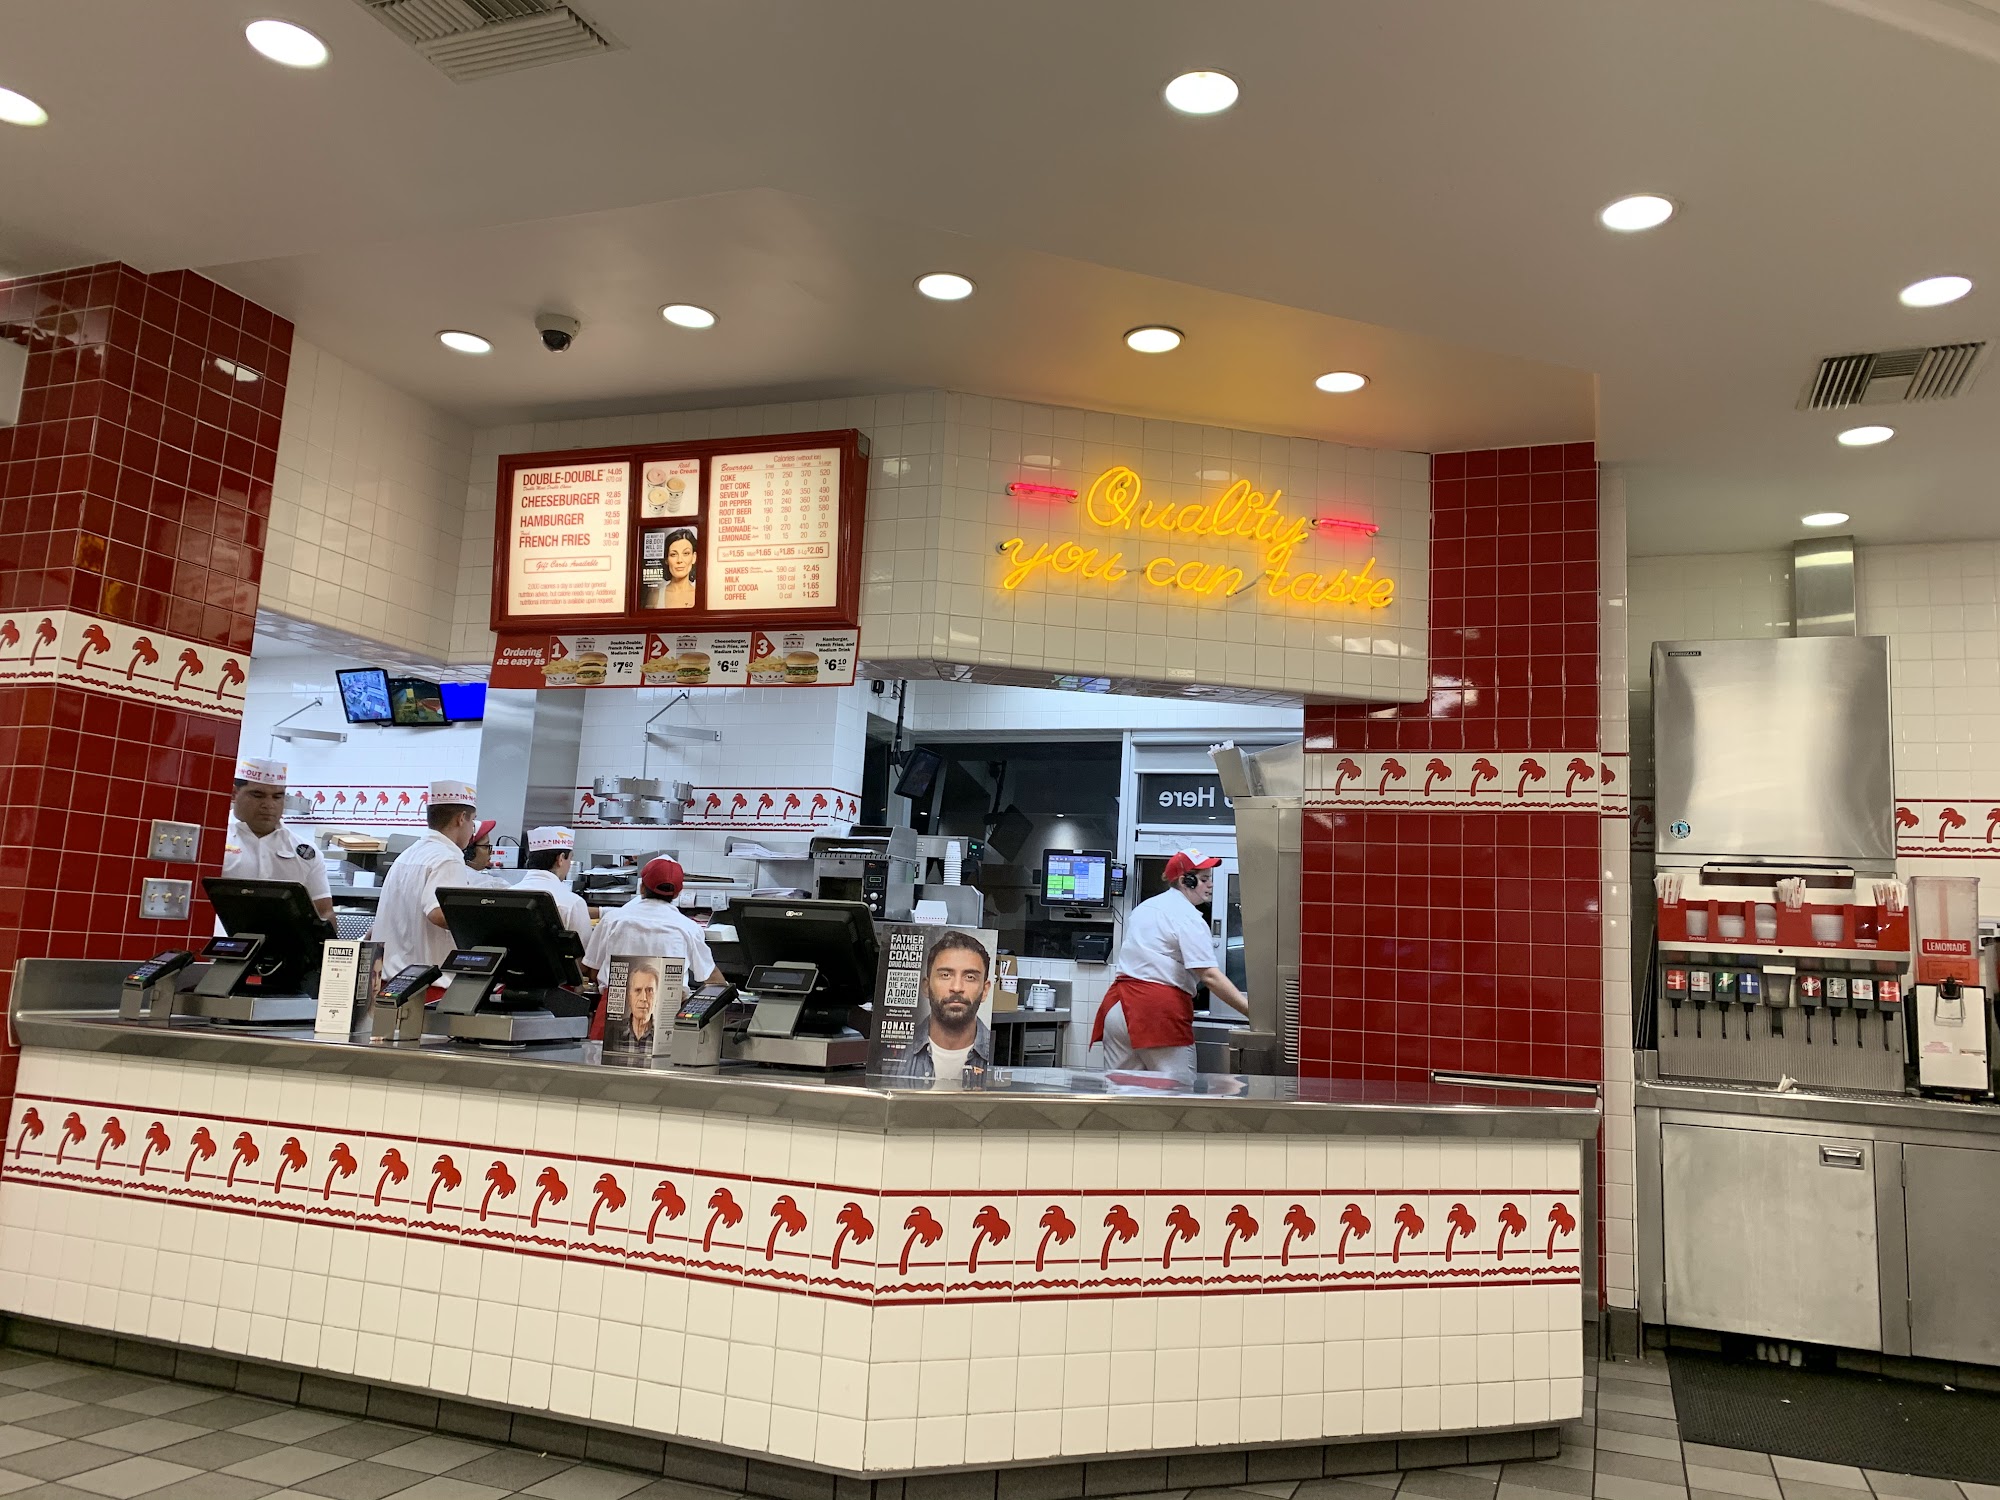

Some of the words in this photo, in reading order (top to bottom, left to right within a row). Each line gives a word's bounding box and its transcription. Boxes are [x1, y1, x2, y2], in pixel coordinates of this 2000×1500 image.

[721, 463, 753, 472] Beverages
[522, 493, 600, 508] CHEESEBURGER
[520, 513, 584, 527] HAMBURGER
[1087, 466, 1307, 564] Quality
[519, 535, 558, 548] FRENCH
[562, 534, 590, 546] FRIES
[997, 538, 1126, 589] you
[1144, 558, 1243, 598] can
[1265, 550, 1394, 607] taste
[503, 647, 543, 658] Ordering
[551, 643, 561, 658] 1
[651, 641, 662, 656] 2
[756, 639, 768, 655] 3
[510, 658, 532, 667] easy
[891, 934, 924, 944] FATHER
[1927, 942, 1967, 952] LEMONADE
[889, 951, 922, 961] COACH
[895, 989, 916, 997] DRUG
[882, 1021, 915, 1030] DONATE
